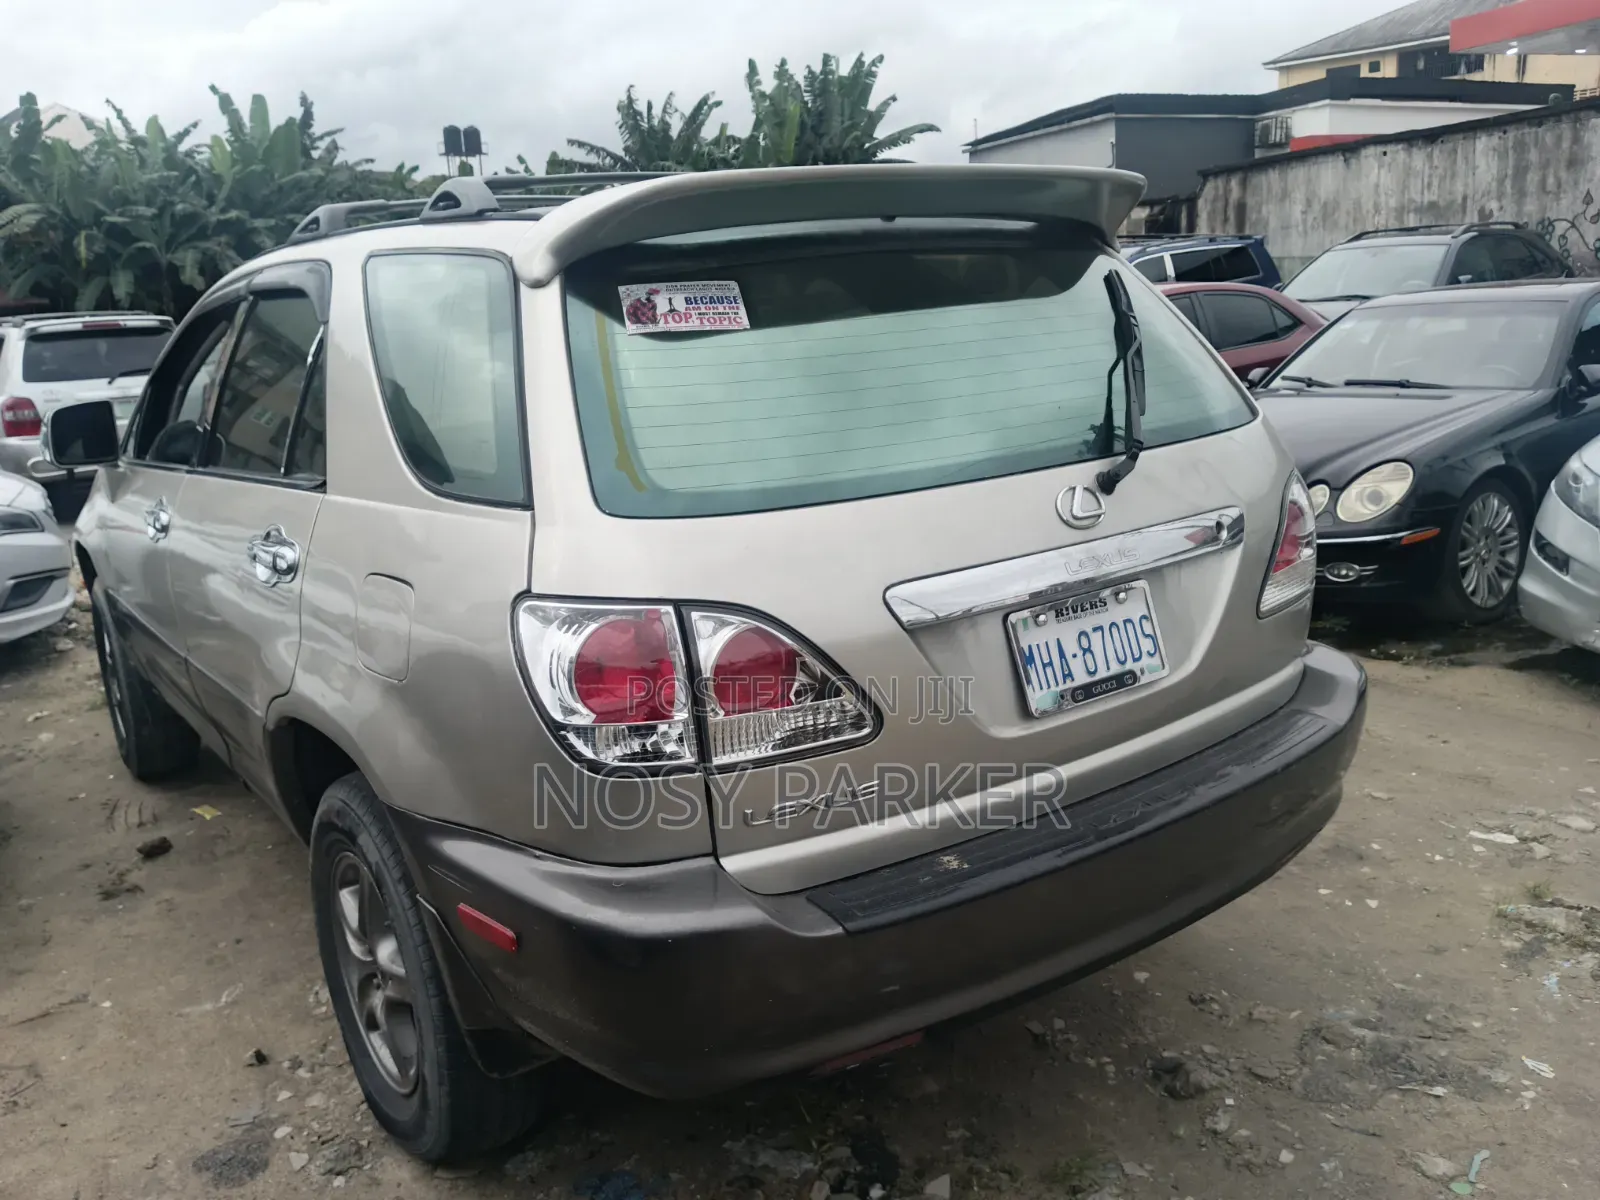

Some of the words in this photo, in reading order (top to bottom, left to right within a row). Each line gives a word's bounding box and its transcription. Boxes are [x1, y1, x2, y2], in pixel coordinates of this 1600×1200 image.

[684, 296, 740, 305] BECAUSE
[696, 316, 743, 325] TOPIC
[1065, 548, 1140, 576] LEXUS
[1054, 598, 1108, 618] RIVERS
[1021, 614, 1158, 692] MHA-870DS
[1092, 680, 1117, 694] GUCCI
[744, 780, 880, 826] LEXUS
